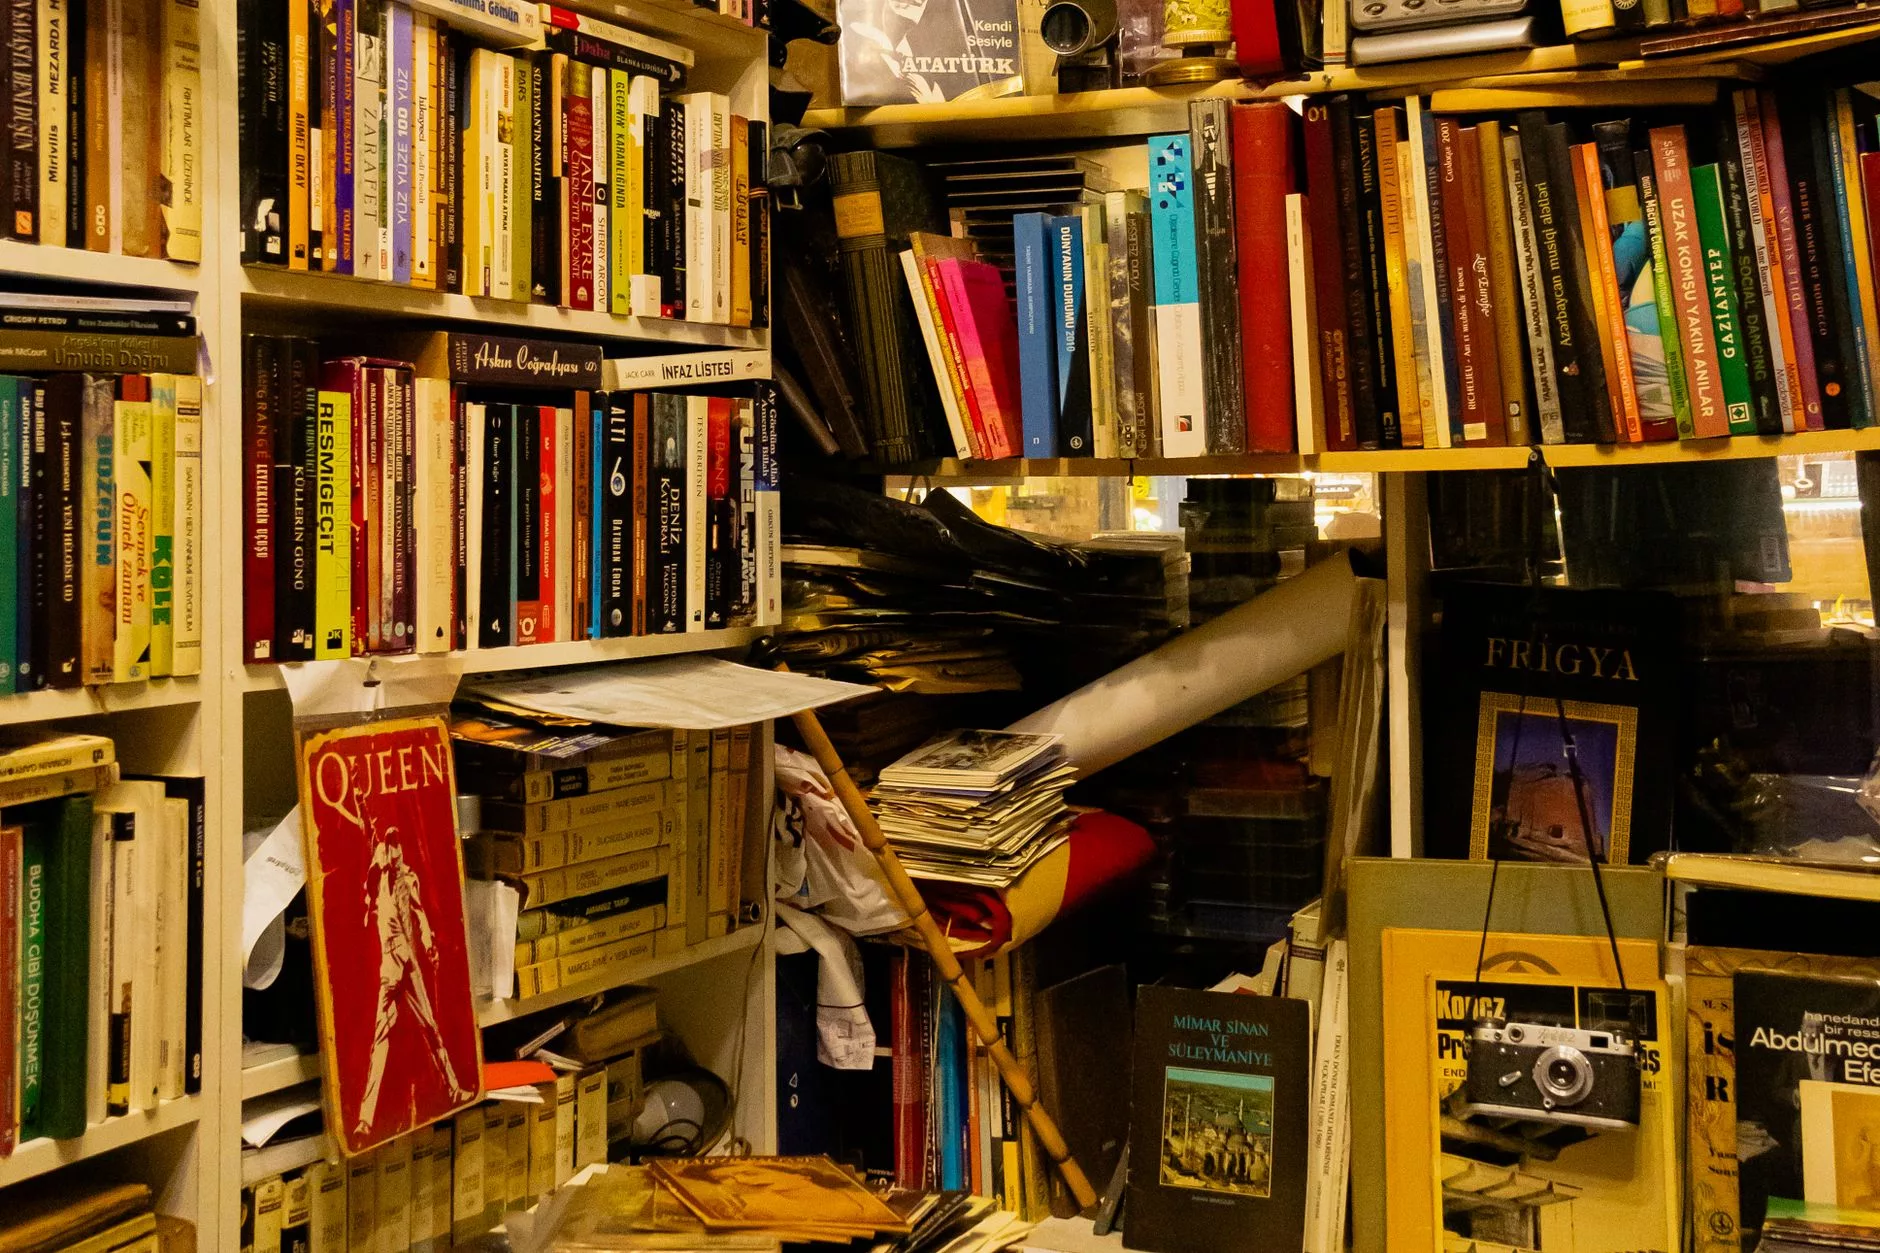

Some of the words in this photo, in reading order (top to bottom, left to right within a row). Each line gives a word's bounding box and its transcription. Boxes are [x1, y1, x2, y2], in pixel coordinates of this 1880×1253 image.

[343, 9, 354, 53] ESENLİK
[489, 1, 520, 24] Gömün
[975, 19, 1013, 34] Kendi
[7, 11, 33, 67] SAVAŞTA
[49, 17, 60, 96] MEZARDA
[967, 35, 1013, 50] Sesiyle
[343, 58, 354, 102] DİLEYİN
[396, 68, 408, 102] YÜZ
[517, 68, 527, 103] PARS
[900, 54, 1015, 75] ATATÜRK
[14, 71, 37, 104] BENİ
[533, 67, 543, 143] SÜLEYMAN'IN
[614, 82, 627, 129] GECENİN
[7, 106, 38, 152] DÜŞÜN
[295, 113, 306, 150] AHMET
[396, 108, 409, 137] 100
[417, 96, 428, 143] hikayeci
[712, 112, 724, 149] ANILARI
[1307, 105, 1328, 122] 01
[1440, 121, 1452, 143] 2001
[448, 115, 458, 163] SEMPOZYUMU
[669, 107, 678, 187] CONNELLY
[675, 111, 685, 184] MICHAEL
[1739, 127, 1750, 145] NEW
[295, 154, 306, 189] OKTAY
[363, 107, 379, 225] ZARAFET
[397, 143, 409, 185] YÜZE
[501, 148, 511, 178] HAYATA
[533, 144, 543, 202] ANAHTARI
[614, 133, 628, 209] KARANLIĞINDA
[712, 149, 724, 194] DÖNEMİN
[1358, 126, 1374, 194] ALEXANDRIA
[1741, 146, 1757, 194] RELIGIOUS
[448, 164, 458, 214] STANDARTLARI
[500, 179, 511, 205] MAKAS
[580, 152, 593, 213] JANE
[1427, 166, 1439, 197] MİLLİ
[1641, 175, 1654, 200] DIGITAL
[1797, 180, 1811, 222] BERBER
[343, 209, 353, 233] TOM
[397, 192, 409, 225] YÜZ
[500, 206, 511, 232] ATMAK
[713, 195, 724, 212] BİR
[1386, 194, 1400, 237] HOTEL
[1515, 182, 1529, 227] DÜNYADAKİ
[1535, 181, 1553, 225] alətləri
[1645, 199, 1660, 226] Macro
[1670, 197, 1688, 242] UZAK
[1747, 194, 1762, 226] WORLD
[343, 235, 353, 262] HESS
[448, 214, 458, 244] SERSERİ
[597, 216, 607, 262] SHERRY
[1543, 228, 1561, 270] musiqi
[1804, 222, 1819, 263] WOMEN
[580, 223, 593, 281] EYRE
[1059, 226, 1074, 282] DÜNYANIN
[1680, 245, 1697, 301] KOMŞU
[1809, 265, 1820, 281] OF
[597, 264, 607, 305] ARGOV
[1737, 255, 1756, 310] SOCIAL
[1759, 265, 1773, 298] Bancroft
[1061, 283, 1076, 329] DURUMU
[1532, 301, 1544, 338] ANADOLU
[1551, 275, 1573, 347] Azərbaycan
[1707, 247, 1737, 359] GAZİANTEP
[1812, 282, 1829, 338] MOROCCO
[1064, 330, 1076, 353] 2010
[1685, 304, 1704, 355] YAKIN
[1746, 314, 1767, 382] DANCING
[54, 348, 117, 367] Umuda
[118, 349, 170, 369] Doğru
[474, 342, 513, 371] Aşkın
[516, 344, 579, 377] Coğrafyası
[661, 363, 694, 381] İNFAZ
[695, 358, 735, 378] LİSTESİ
[1332, 328, 1346, 381] OTTO
[34, 389, 46, 409] Bay
[370, 383, 378, 402] ANNA
[395, 386, 404, 407] ANNA
[768, 389, 778, 405] Ay
[1464, 365, 1477, 411] RICHELIEU
[1693, 358, 1715, 418] ANILAR
[22, 396, 31, 435] JUDITH
[370, 403, 378, 441] KATHARINE
[395, 408, 404, 455] KATHARINE
[610, 406, 626, 443] ALTI
[696, 416, 705, 438] TESS
[761, 399, 772, 443] Amentü
[769, 408, 780, 455] Gördüm
[1336, 380, 1351, 442] NAGEL
[21, 435, 30, 488] HERMANN
[61, 442, 72, 492] rousseau
[696, 440, 705, 498] GERRITSEN
[761, 446, 772, 477] Billah
[769, 458, 779, 488] Allah
[255, 463, 271, 524] LEYLEKLERİN
[294, 466, 306, 542] KÜLLERİN
[63, 504, 74, 531] YENİ
[121, 491, 137, 553] Ölmek
[543, 512, 551, 539] İSMAİL
[660, 477, 672, 555] KATEDRALİ
[670, 488, 683, 545] DENİZ
[767, 509, 775, 539] ORKUN
[136, 505, 150, 579] Sevmek
[253, 528, 268, 559] UÇUŞU
[543, 540, 551, 579] GÜZELSOY
[767, 540, 775, 579] ERTENER
[150, 534, 173, 627] KÖLE
[293, 546, 304, 591] GÜNÜ
[395, 562, 404, 594] BEBEK
[740, 530, 750, 605] WEAVER
[747, 552, 756, 586] TIM
[121, 558, 133, 626] zamanı
[136, 582, 147, 603] ve
[662, 564, 672, 616] FALCONES
[1483, 633, 1640, 683] FRİGYA
[316, 743, 445, 826] QUEEN
[28, 863, 43, 938] BUDDHA
[27, 943, 42, 979] GİBİ
[24, 982, 41, 1089] DÜŞÜNMEK
[1172, 1015, 1222, 1033] MİMAR
[1226, 1020, 1270, 1037] SİNAN
[1210, 1033, 1231, 1048] VE
[1824, 1023, 1843, 1036] bir
[1168, 1043, 1274, 1067] SÜLEYMANİYE
[1333, 1034, 1343, 1061] ERKEN
[1330, 1061, 1340, 1090] DÖNEM
[1326, 1090, 1338, 1125] OSMANLI
[1322, 1124, 1335, 1177] MİMARİSİNDE
